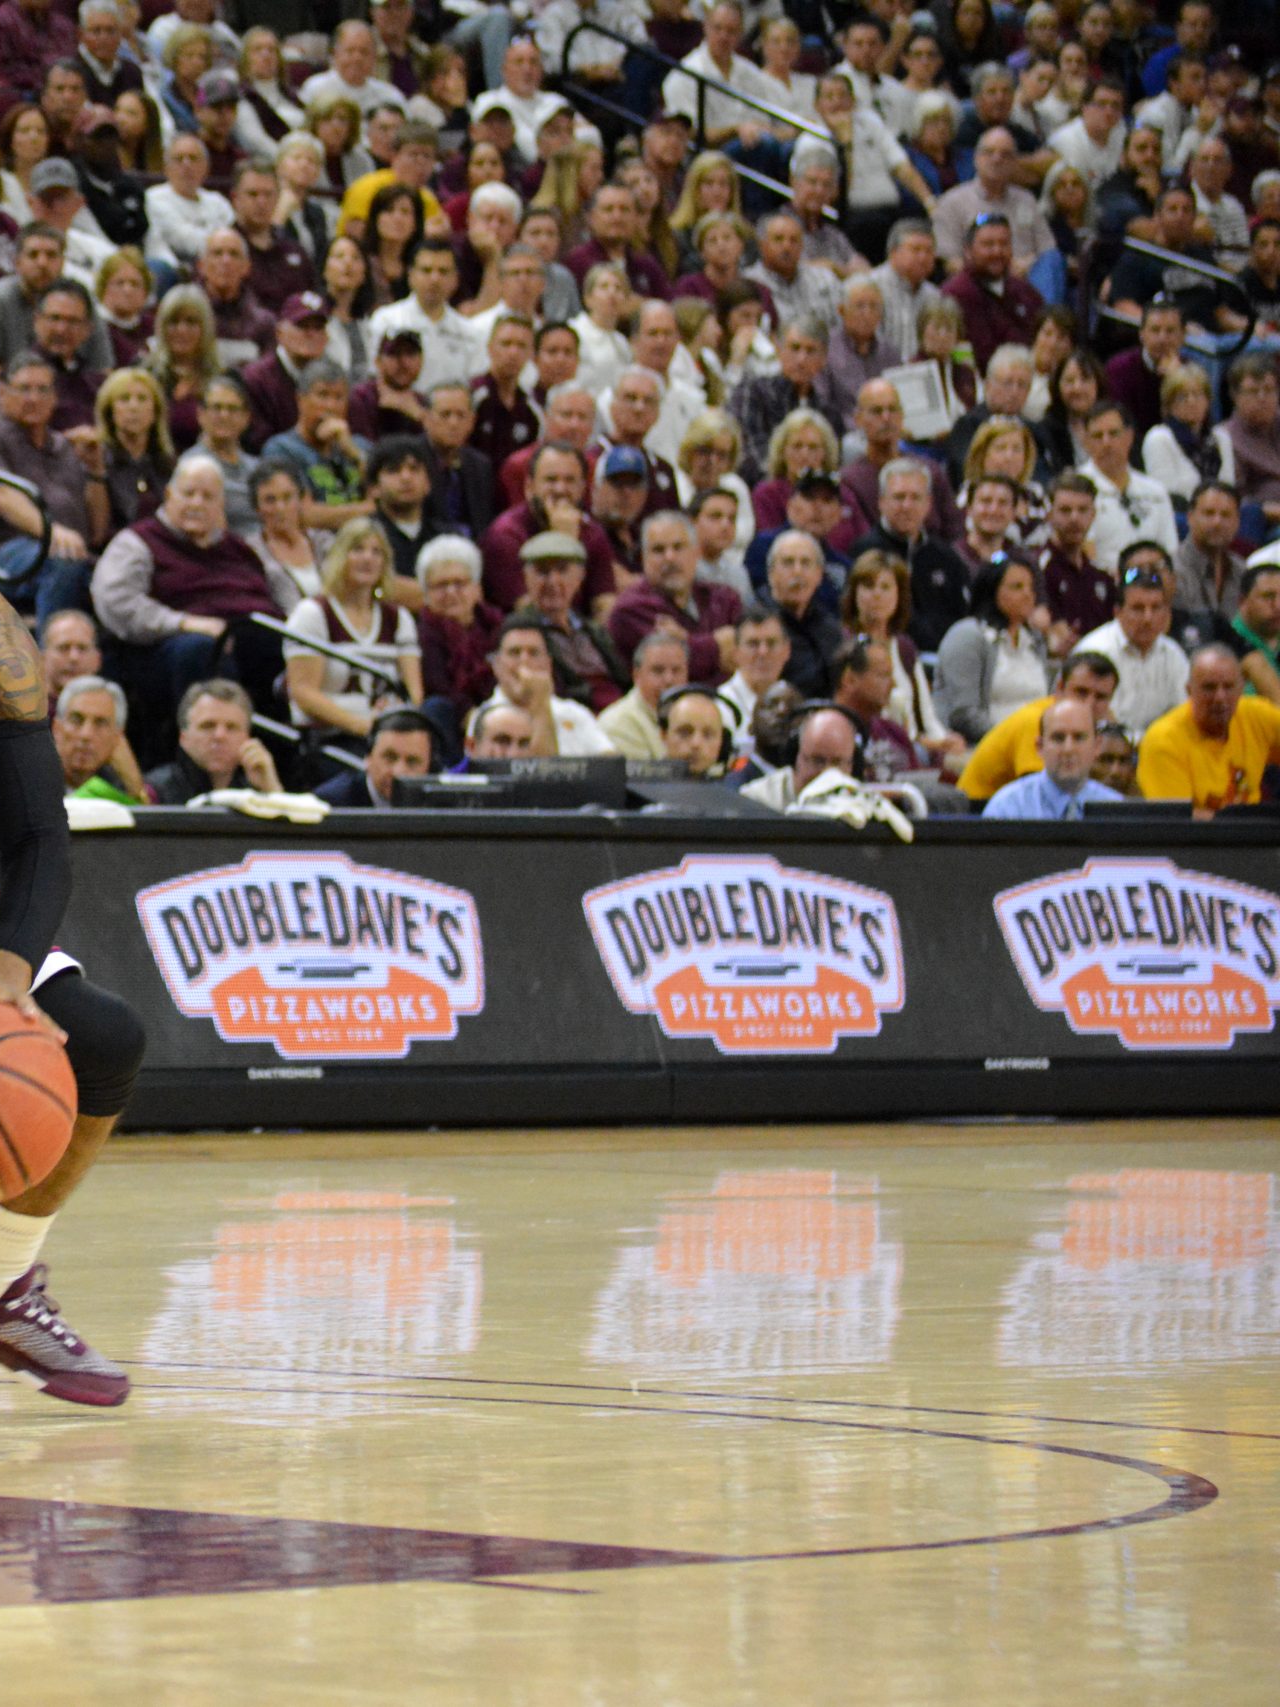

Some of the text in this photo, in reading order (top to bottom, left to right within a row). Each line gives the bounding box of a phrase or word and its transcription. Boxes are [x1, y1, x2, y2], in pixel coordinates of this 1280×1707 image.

[228, 994, 437, 1024] PIZZAWORKS
[670, 992, 862, 1020] PIZZAWORKS
[1076, 989, 1257, 1017] PIZZAWORKS
